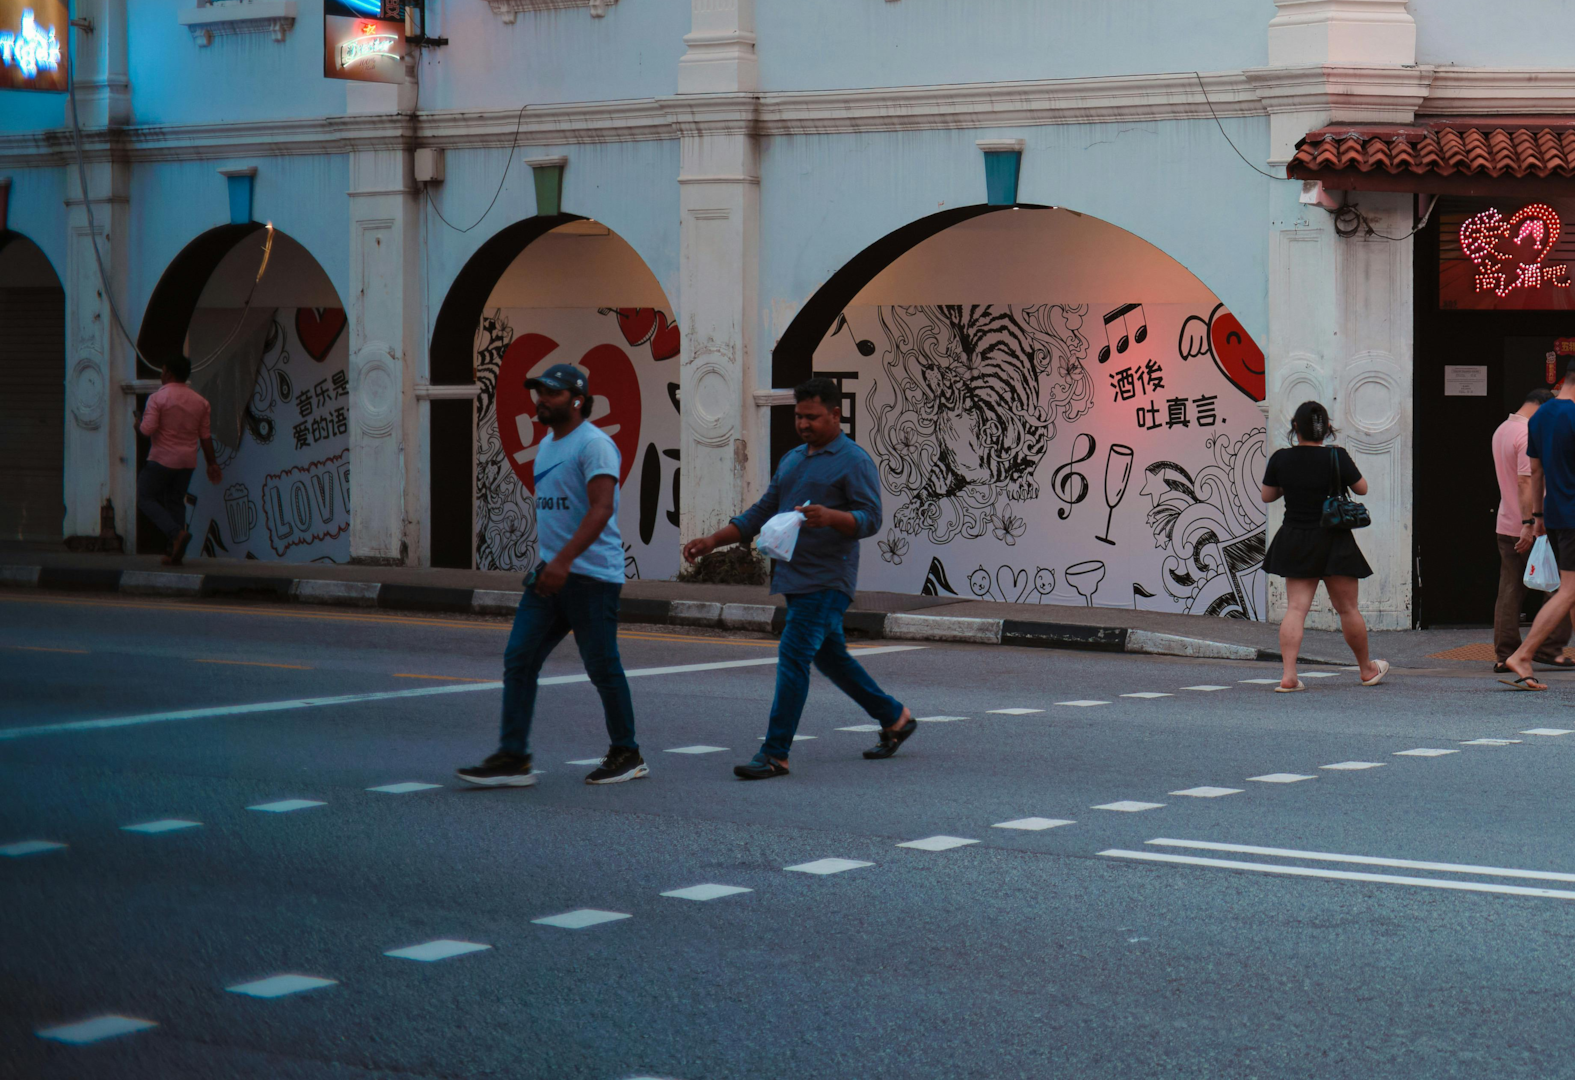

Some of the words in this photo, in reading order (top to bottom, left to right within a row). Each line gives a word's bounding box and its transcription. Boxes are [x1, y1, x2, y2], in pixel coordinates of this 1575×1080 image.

[294, 369, 349, 418] 音乐是
[1109, 358, 1165, 403] 酒後
